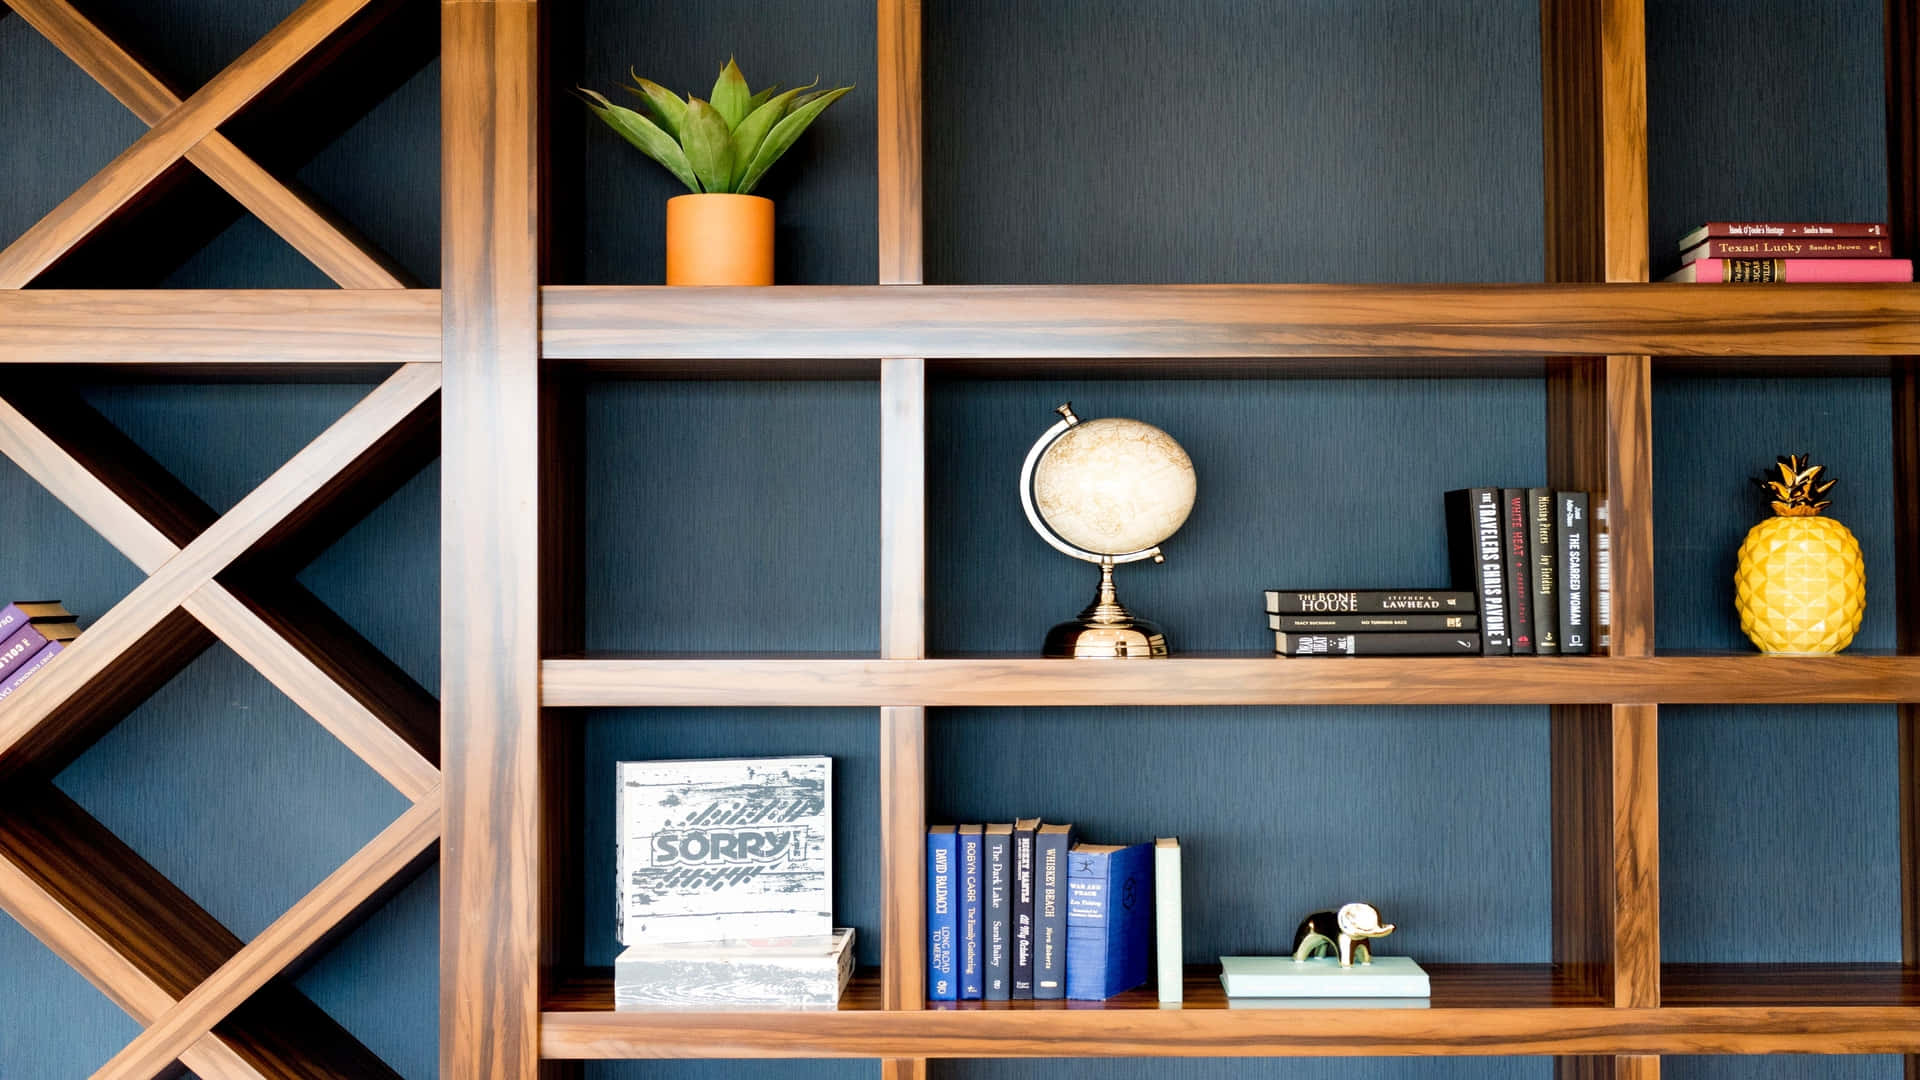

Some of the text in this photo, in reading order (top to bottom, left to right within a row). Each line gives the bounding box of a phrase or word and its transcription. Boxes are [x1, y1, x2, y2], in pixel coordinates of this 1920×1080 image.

[1719, 242, 1802, 254] Texas! Lucky
[1479, 492, 1500, 561] THE TRAVELERS
[1511, 497, 1524, 557] WHITE HEAT
[1537, 496, 1551, 544] Missing Pieces
[1318, 592, 1358, 601] BONE
[1482, 563, 1505, 637] CHRIS PAVONE
[1539, 555, 1553, 595] Joy Fielding
[1568, 533, 1582, 625] THE SCARRED WOMAN
[1302, 600, 1358, 612] HOUSE
[935, 849, 948, 914] DAVID BALDACCI
[967, 842, 976, 903] ROBYN CARR
[991, 844, 1003, 909] The Dark Lake
[1045, 848, 1056, 917] WHISKEY BEACH
[933, 930, 941, 970] TO MERCY
[941, 926, 951, 974] LONG ROAD
[965, 908, 976, 975] The Family Gathering
[990, 920, 1002, 968] Sarah Bailey
[1045, 944, 1053, 969] Roberts
